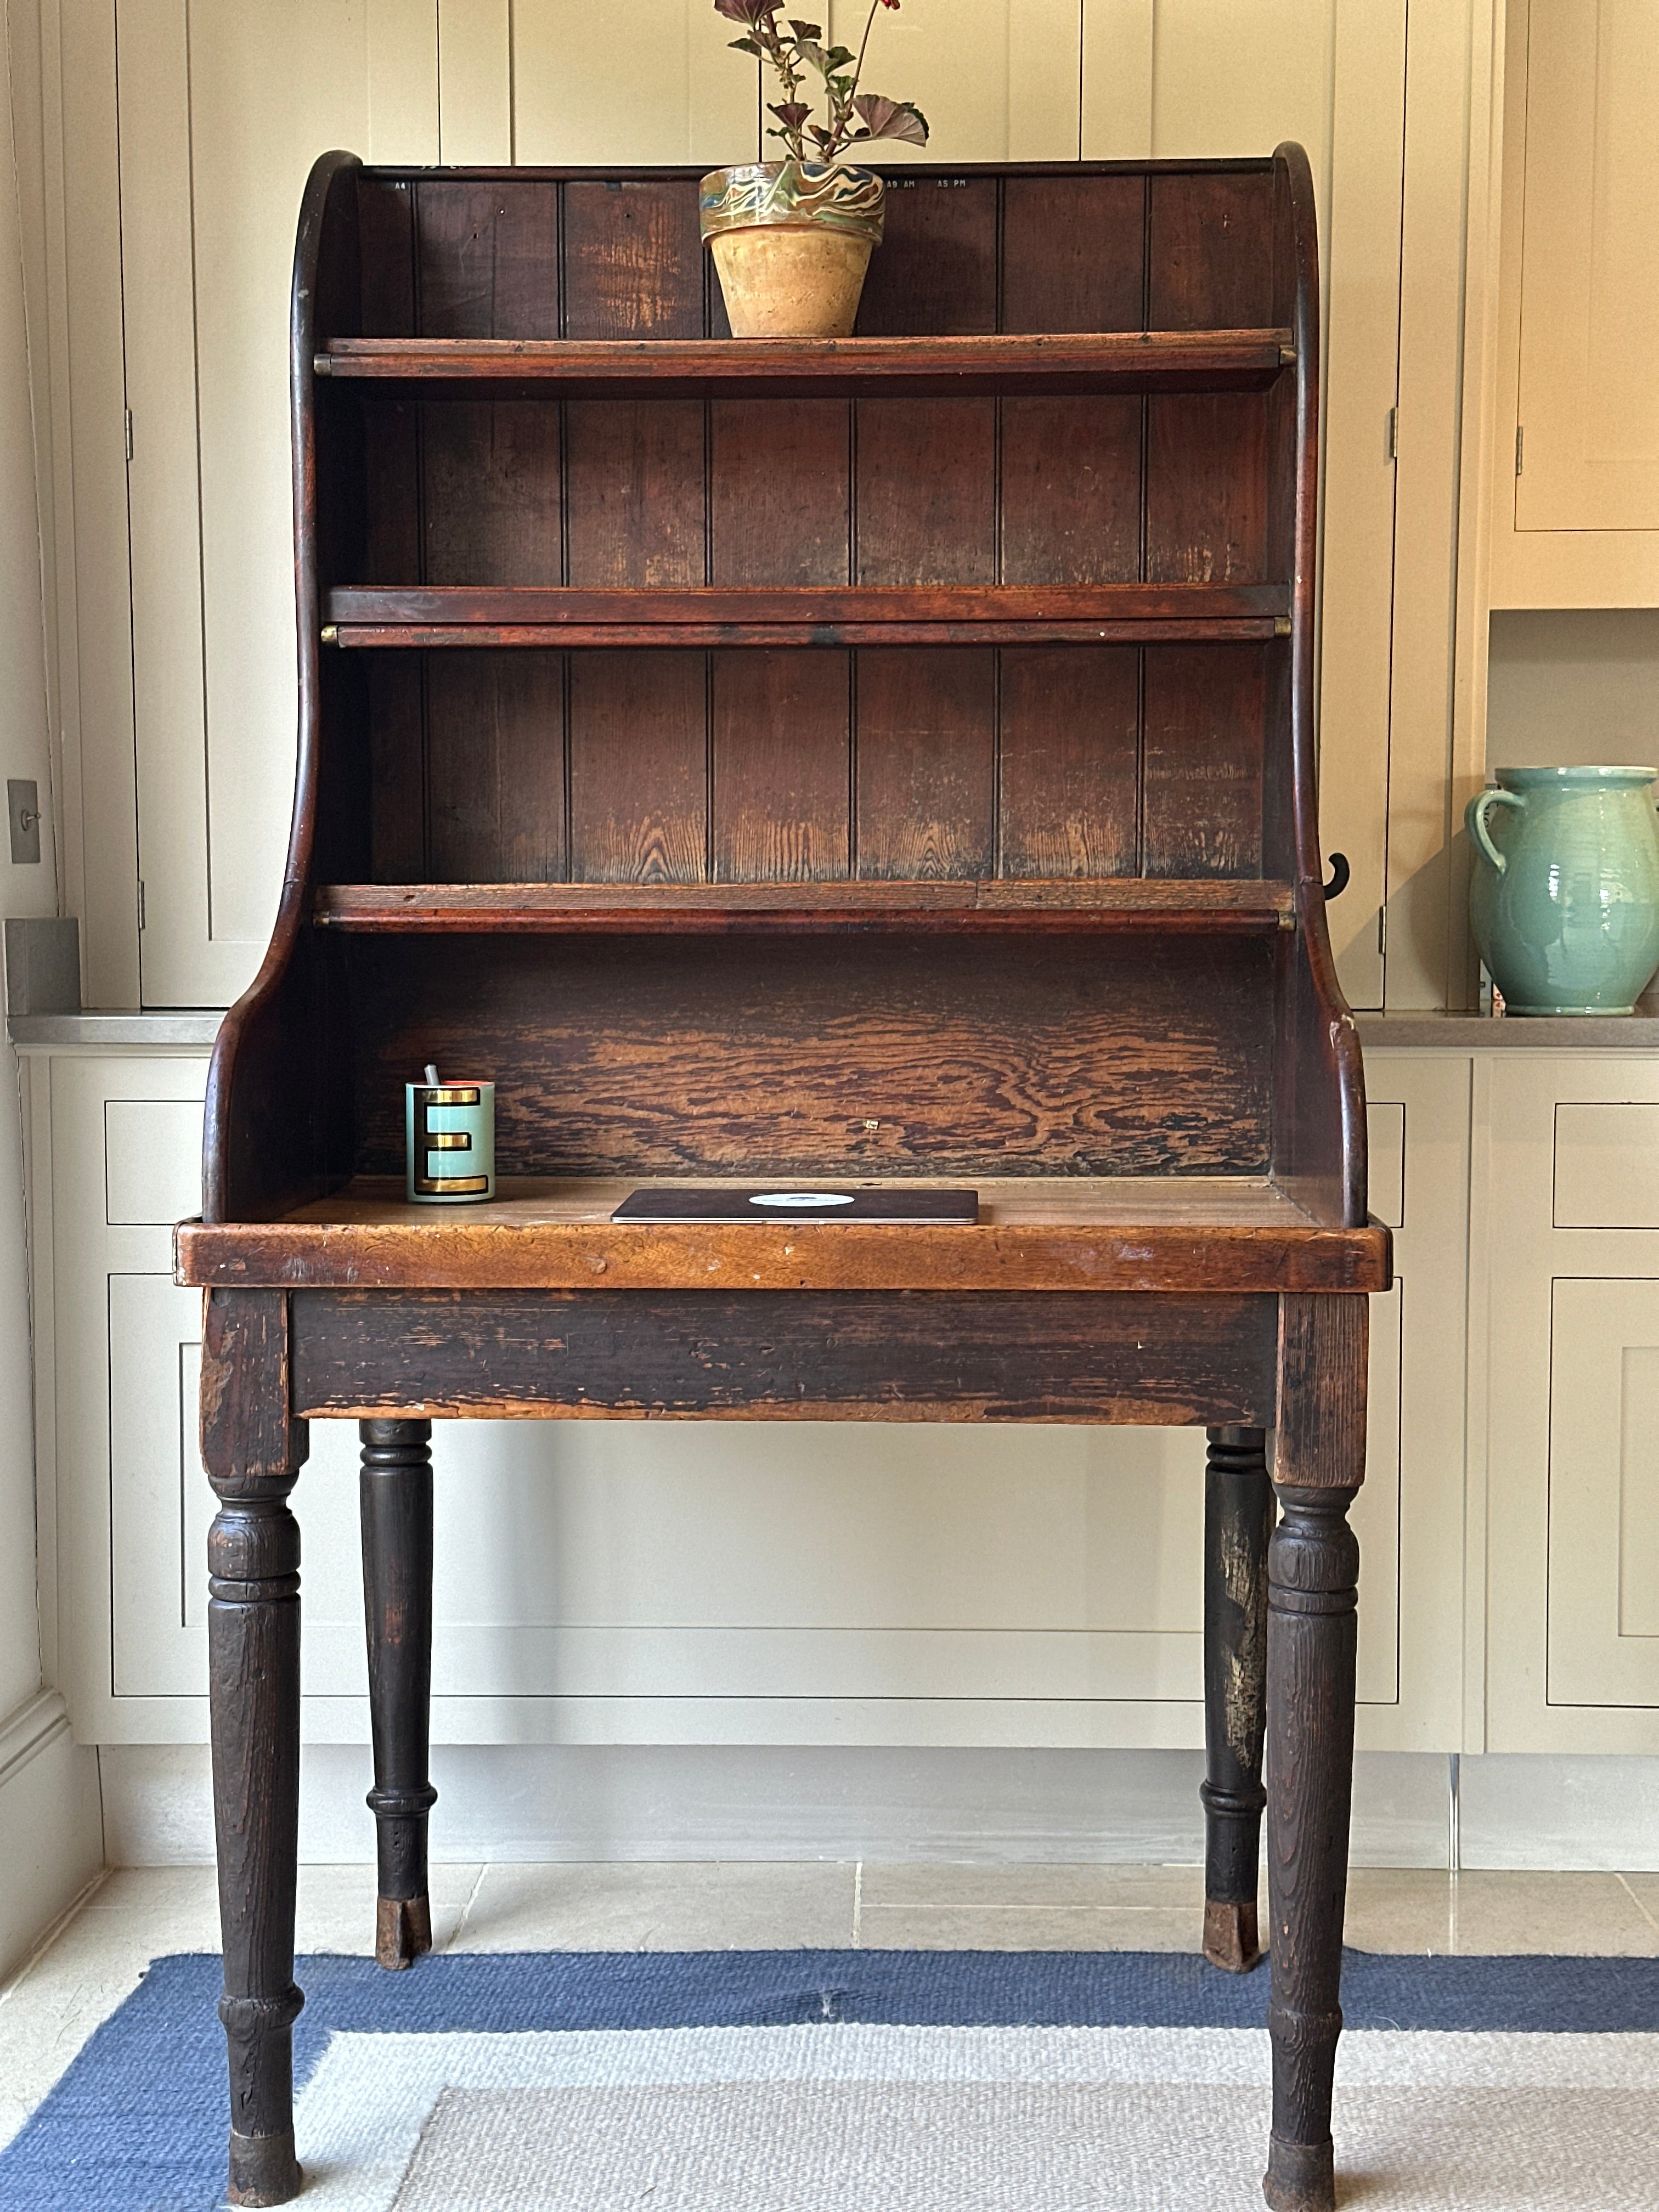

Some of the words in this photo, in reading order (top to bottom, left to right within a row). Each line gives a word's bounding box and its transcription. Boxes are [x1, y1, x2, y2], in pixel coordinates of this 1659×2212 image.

[904, 180, 915, 188] AM
[953, 179, 966, 187] PM
[414, 1087, 488, 1196] E
